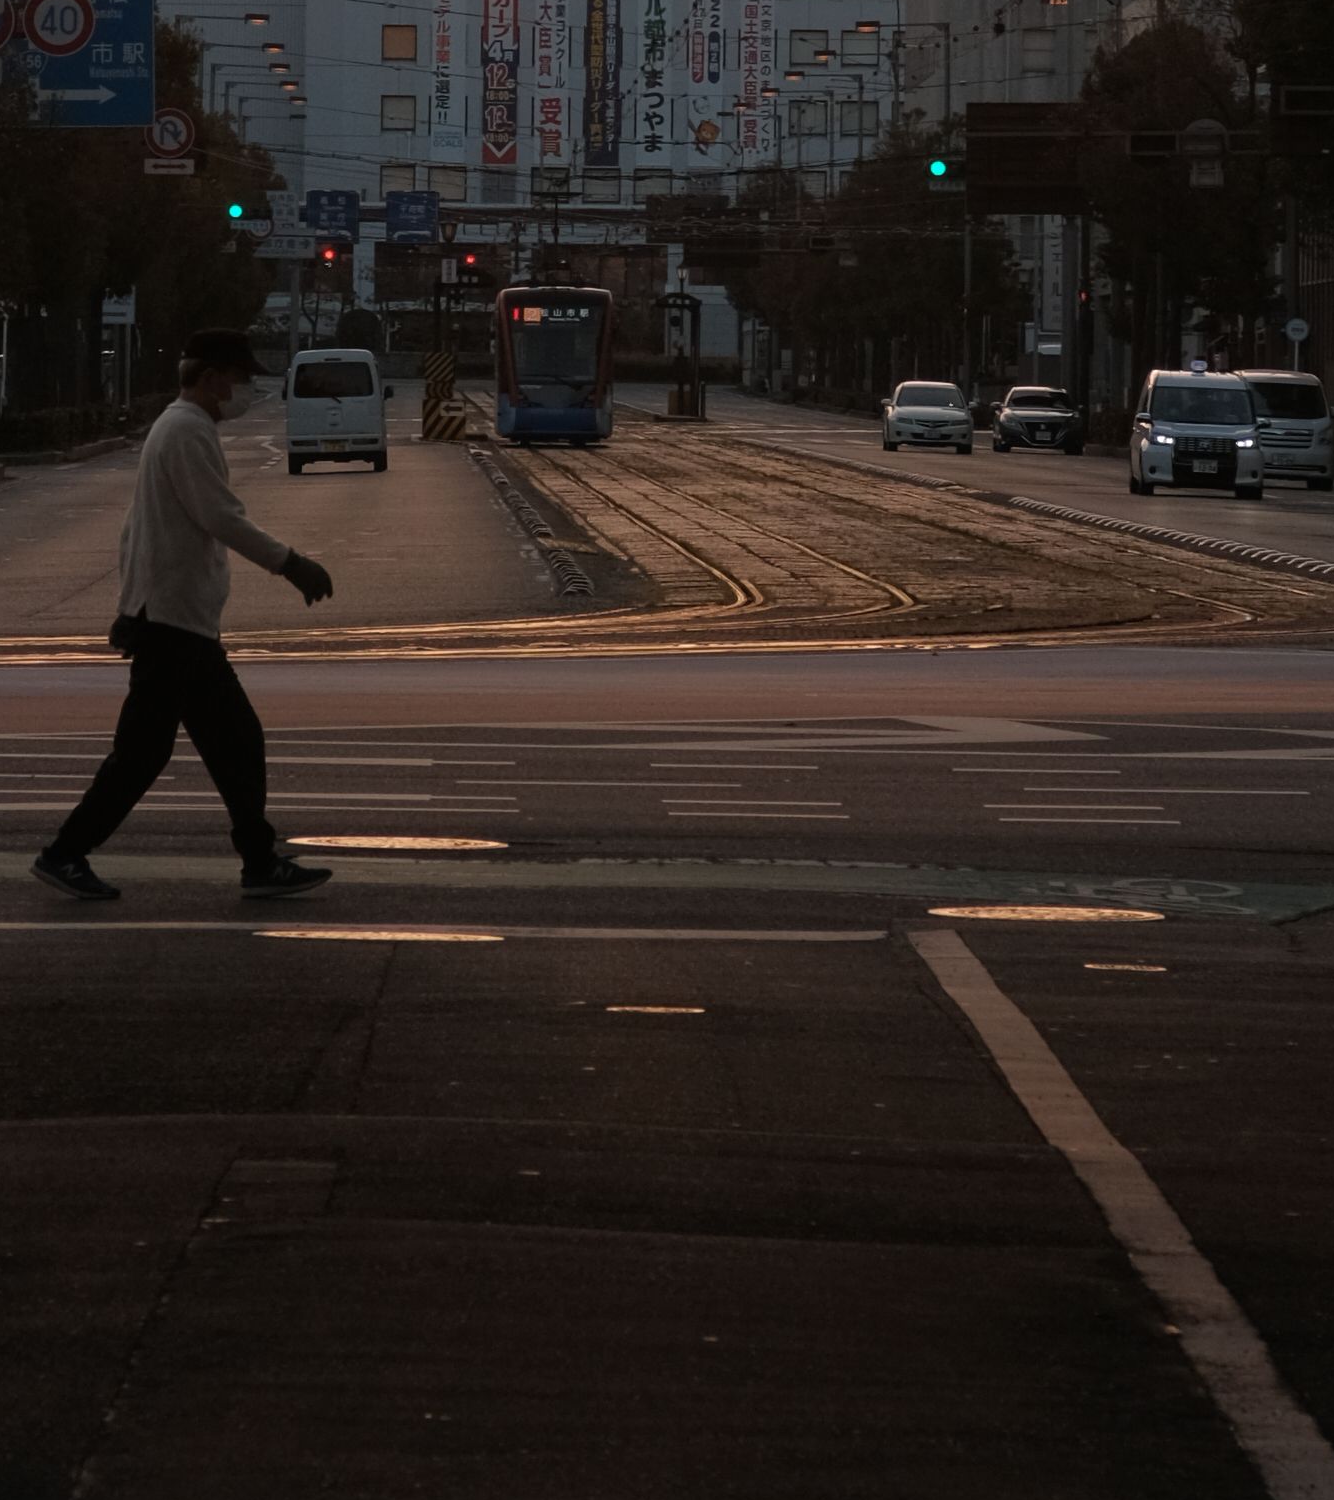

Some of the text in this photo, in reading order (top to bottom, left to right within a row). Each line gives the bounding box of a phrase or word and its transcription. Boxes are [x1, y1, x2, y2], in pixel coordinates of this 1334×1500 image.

[41, 5, 78, 35] 40
[90, 42, 146, 65] 市駅
[540, 97, 562, 158] 受賞
